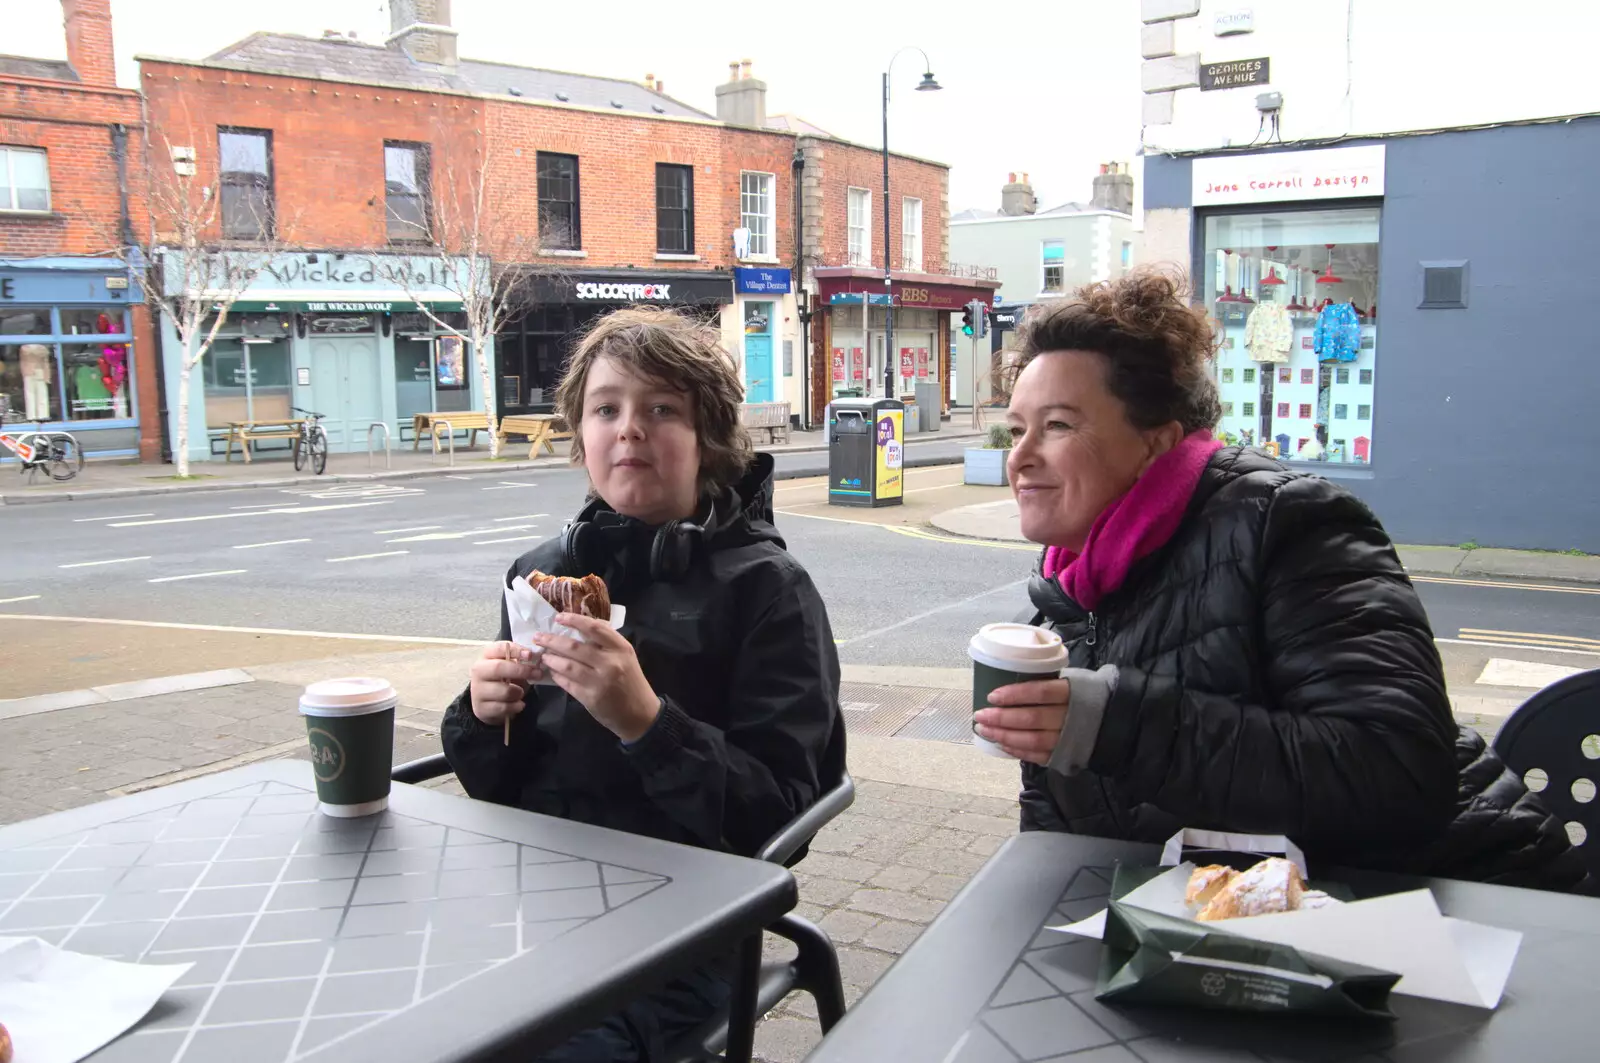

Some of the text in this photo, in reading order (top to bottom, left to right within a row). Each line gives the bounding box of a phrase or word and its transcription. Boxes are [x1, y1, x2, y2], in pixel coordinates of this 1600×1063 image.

[1216, 13, 1251, 24] ACTION
[1208, 61, 1262, 75] GEORGES
[1213, 72, 1257, 86] AVENUE
[1206, 175, 1369, 194] Jane Carroll Design
[266, 260, 375, 283] Wicked
[385, 261, 449, 285] Wolf
[760, 272, 773, 281] The
[1, 278, 15, 299] E
[745, 280, 787, 291] Village Dentist
[901, 287, 929, 303] EBS
[307, 302, 393, 311] THE WICKED WOLF
